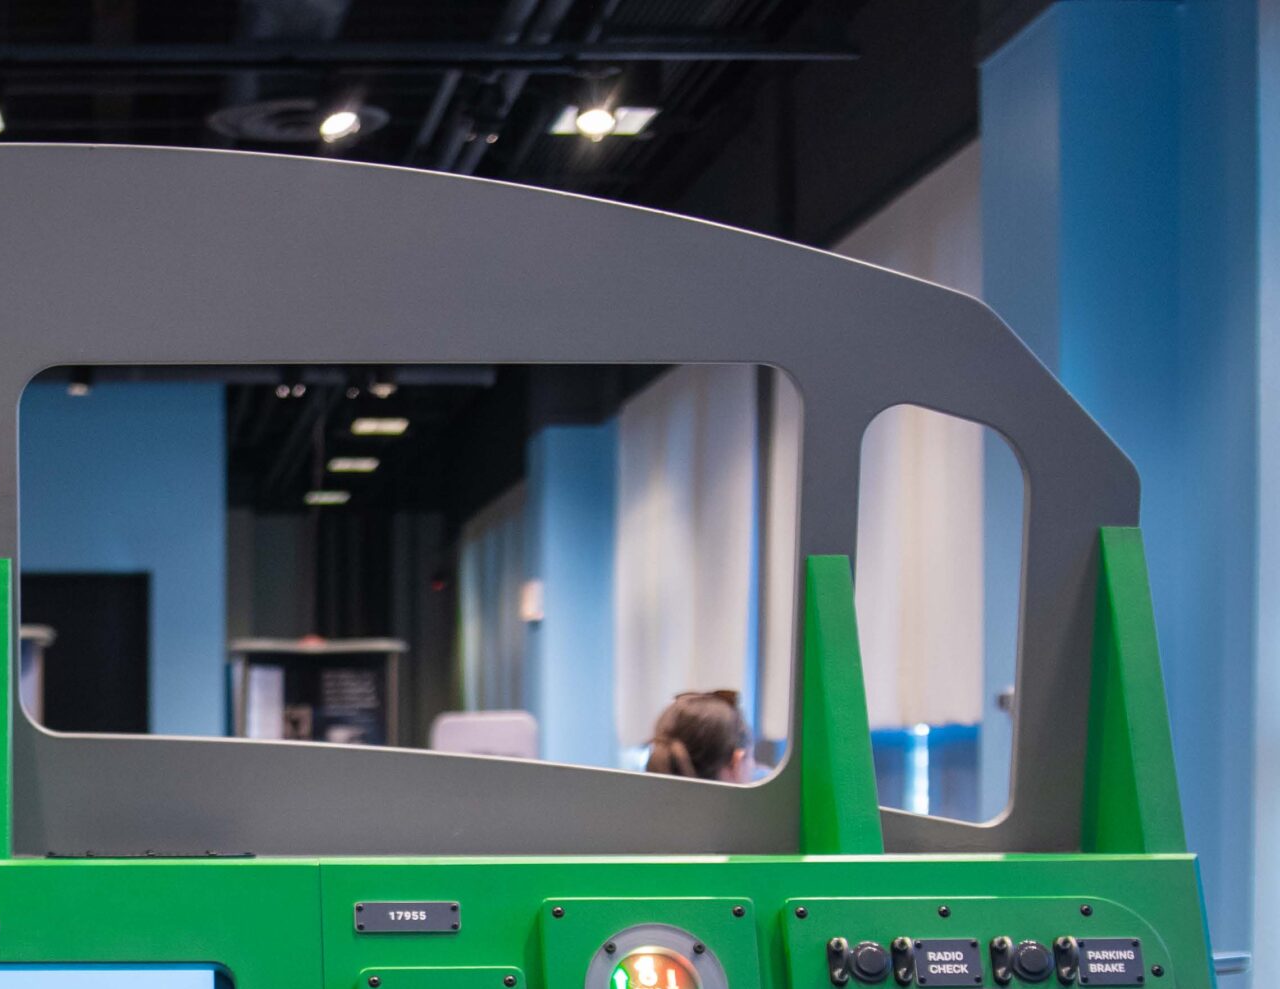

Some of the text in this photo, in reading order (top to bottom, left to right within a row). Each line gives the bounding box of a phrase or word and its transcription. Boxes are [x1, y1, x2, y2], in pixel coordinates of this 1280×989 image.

[388, 911, 427, 920] 17955
[926, 951, 964, 962] RADIO
[1087, 950, 1135, 960] PARKING
[928, 963, 969, 974] CHECK
[1088, 963, 1126, 973] BRAKE
